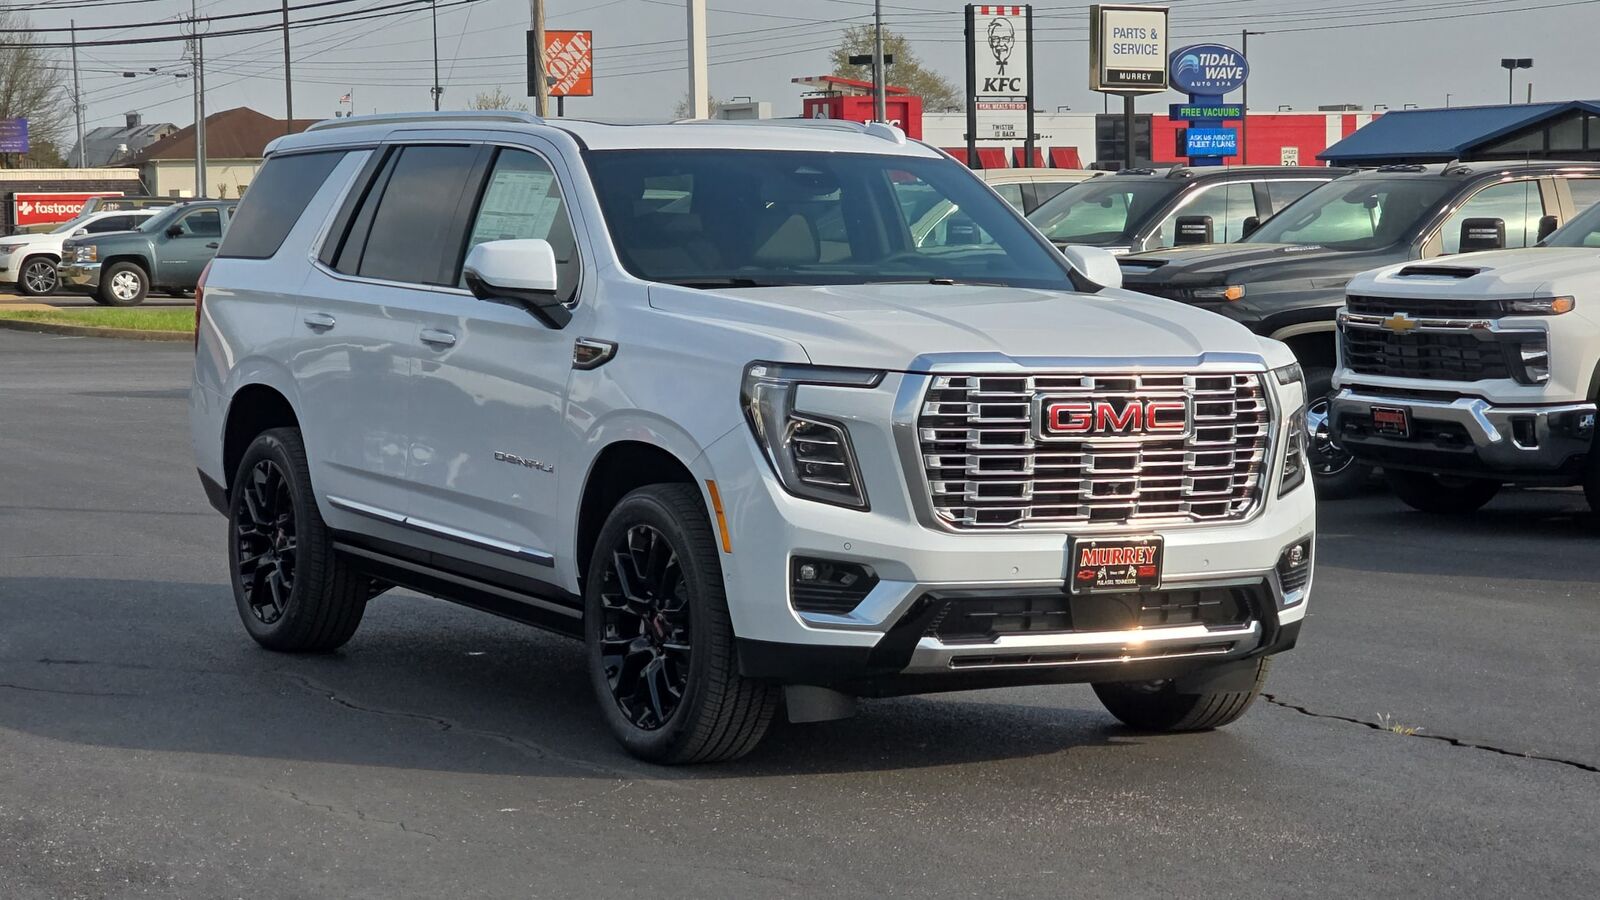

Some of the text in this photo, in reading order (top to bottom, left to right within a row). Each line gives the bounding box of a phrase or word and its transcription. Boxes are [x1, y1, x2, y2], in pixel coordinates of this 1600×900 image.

[1113, 27, 1158, 39] PARTS &
[1113, 43, 1159, 55] SERVICE
[1200, 53, 1236, 66] TIDAL
[558, 54, 592, 95] DEPOT
[1119, 72, 1152, 80] MURREY
[1205, 67, 1243, 79] WAVE
[982, 77, 1021, 92] KFC
[1180, 107, 1240, 117] FREE VACUUMS
[1047, 402, 1186, 433] GMC
[494, 450, 554, 473] DENALI
[1080, 546, 1157, 567] MURREY
